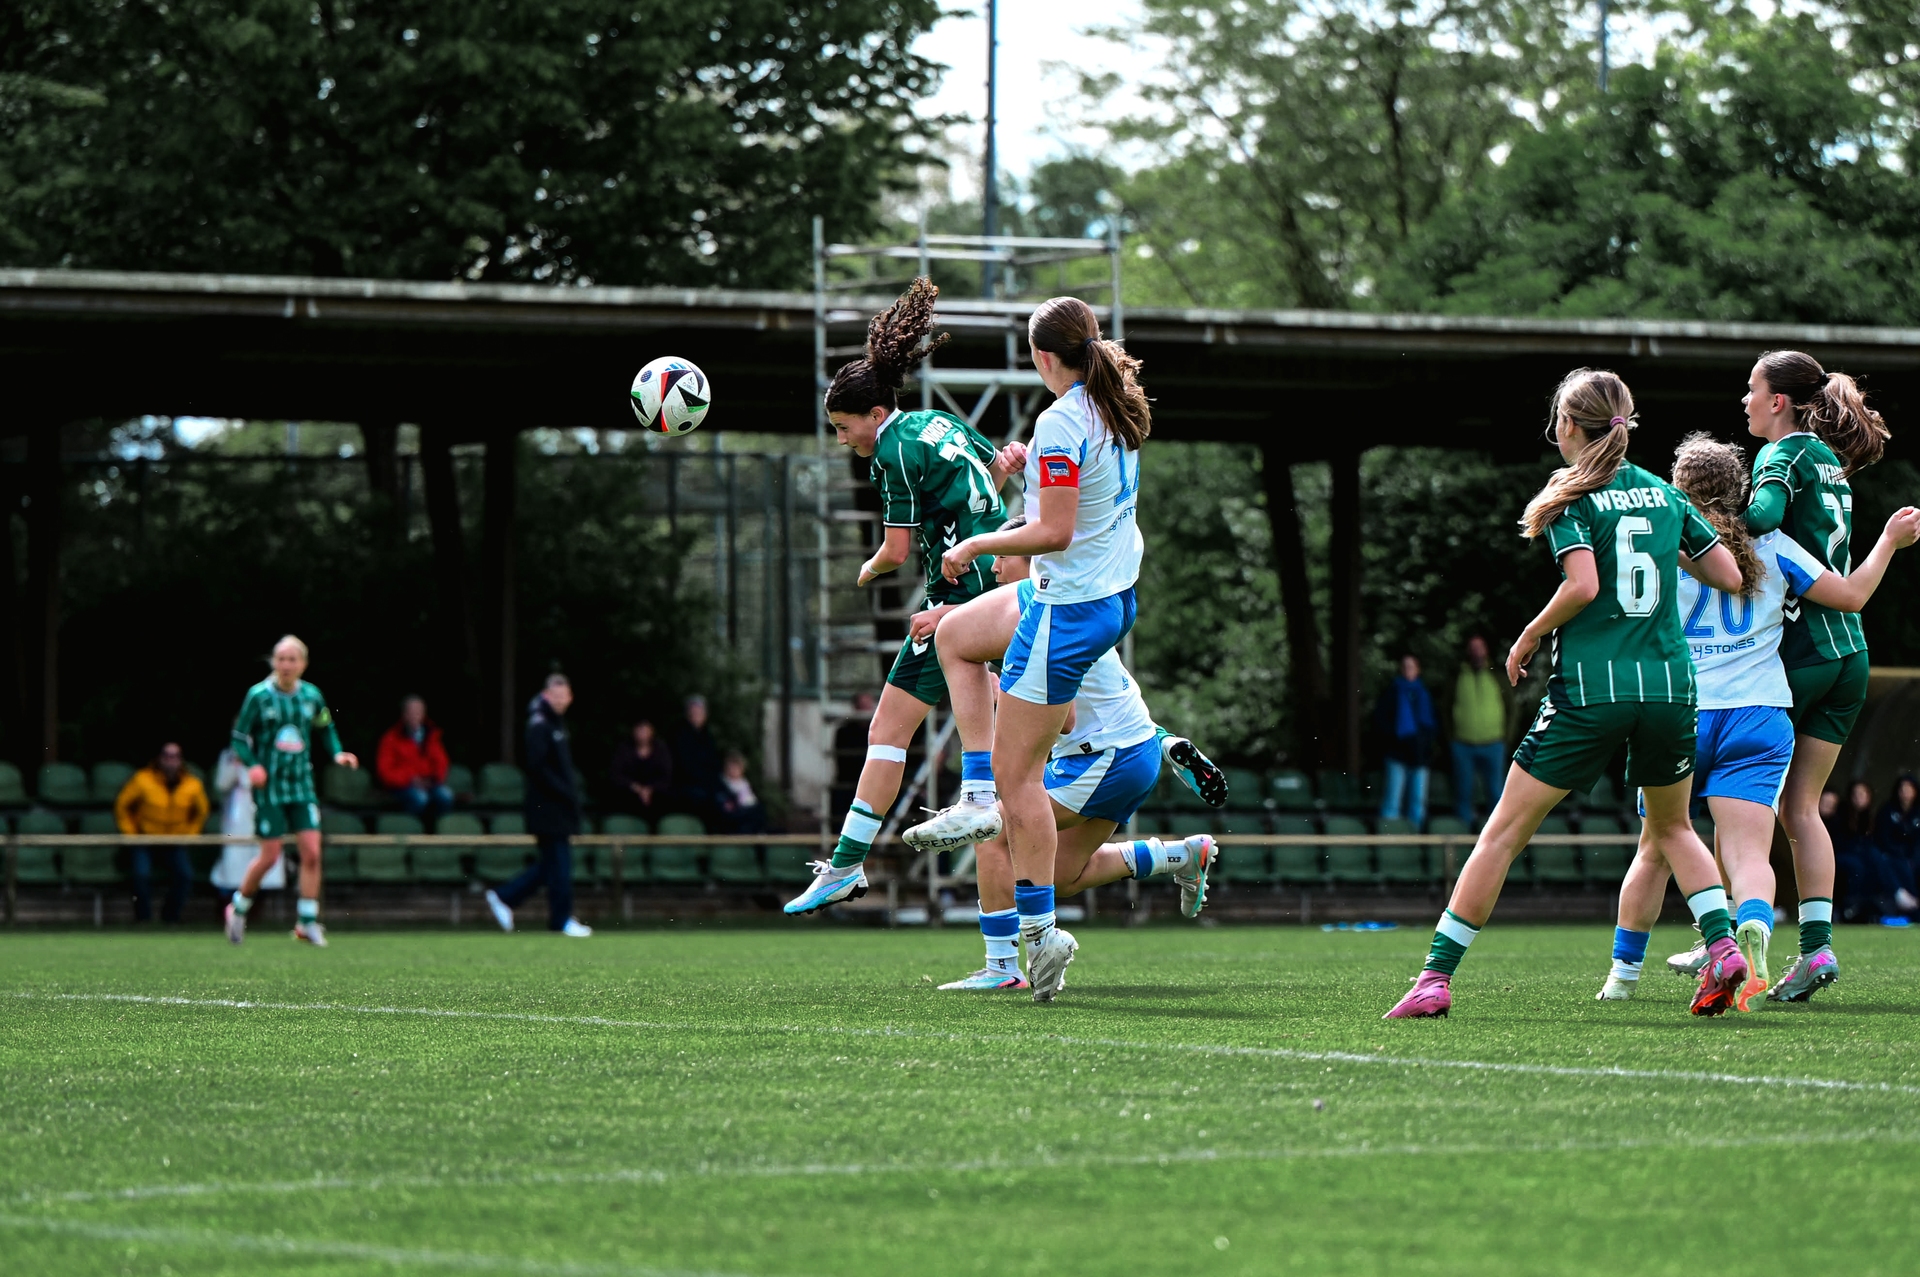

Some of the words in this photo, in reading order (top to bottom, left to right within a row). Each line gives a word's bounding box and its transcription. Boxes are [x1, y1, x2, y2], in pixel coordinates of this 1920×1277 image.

[1588, 487, 1669, 513] WERDER
[1615, 515, 1661, 618] 6
[1678, 567, 1755, 639] 20
